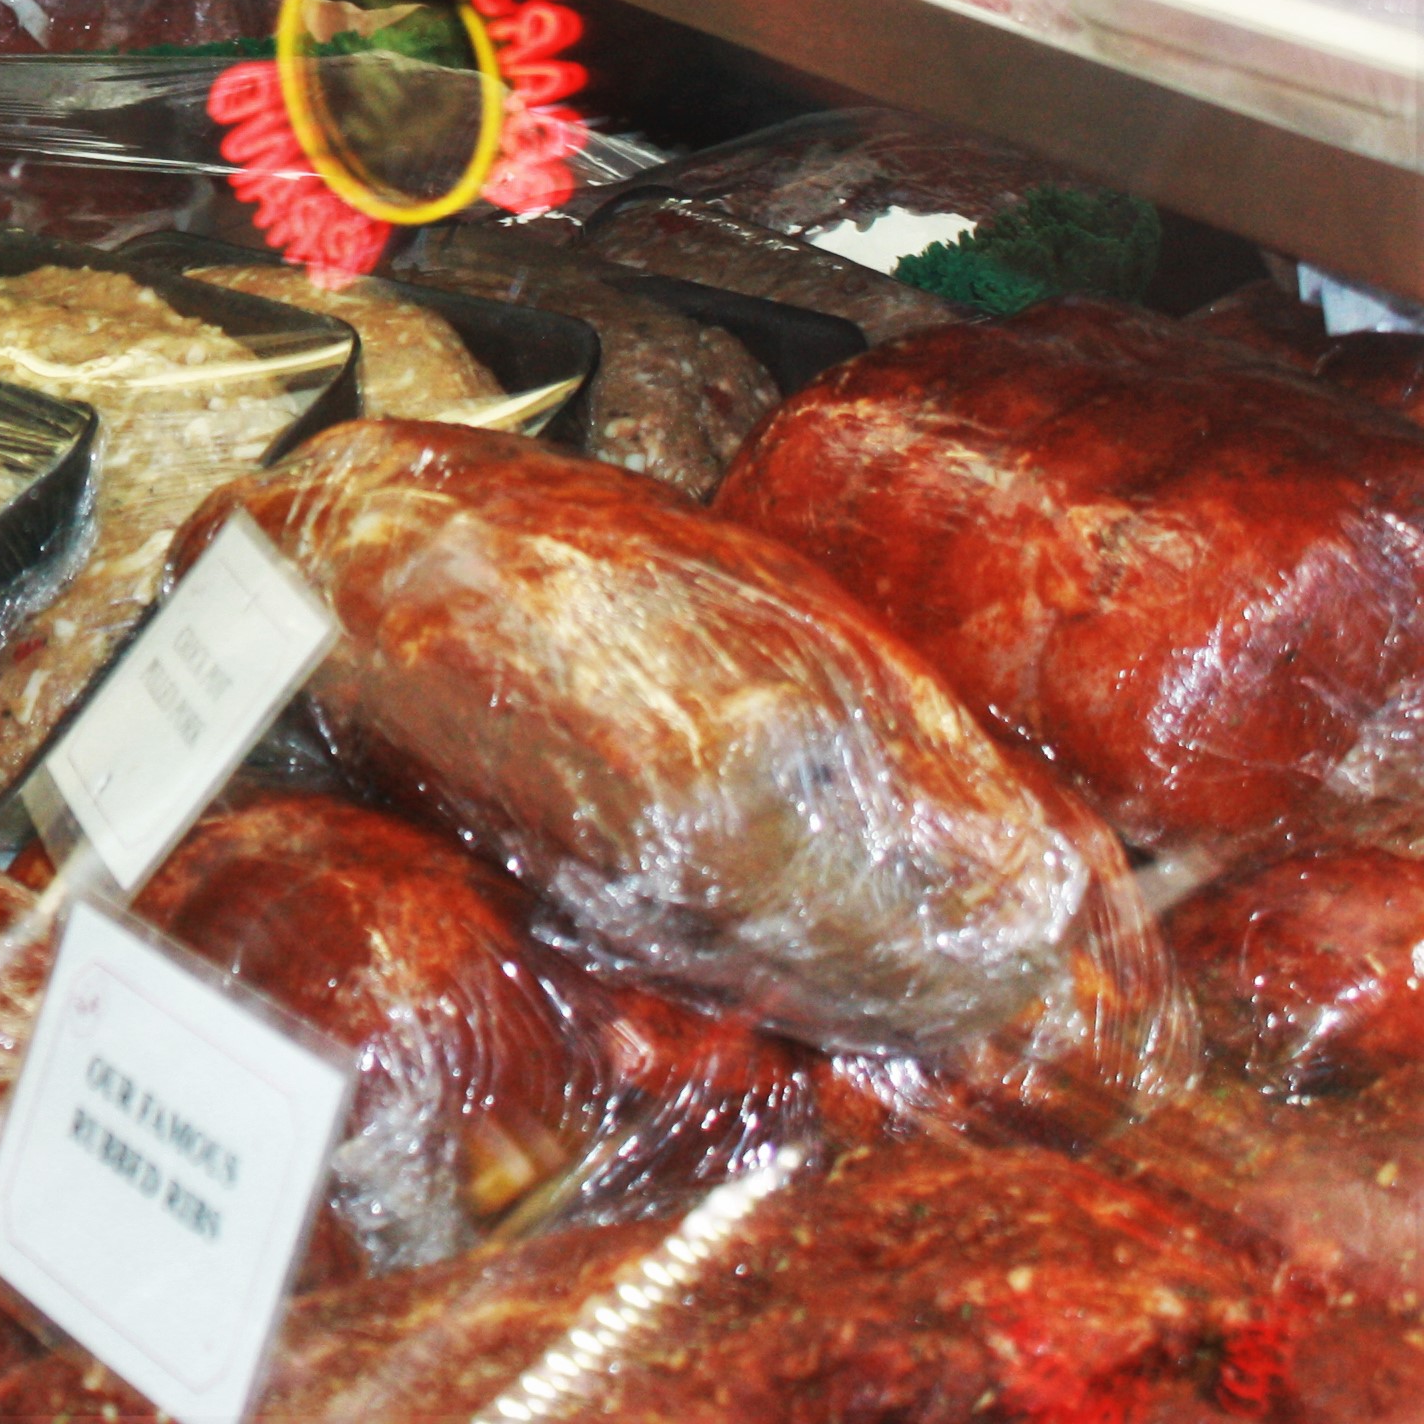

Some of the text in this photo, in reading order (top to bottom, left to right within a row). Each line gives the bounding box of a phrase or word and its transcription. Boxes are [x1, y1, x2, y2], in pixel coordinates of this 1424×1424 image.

[66, 1105, 162, 1199] RUBBED
[86, 1055, 241, 1190] OUR FAMOUS
